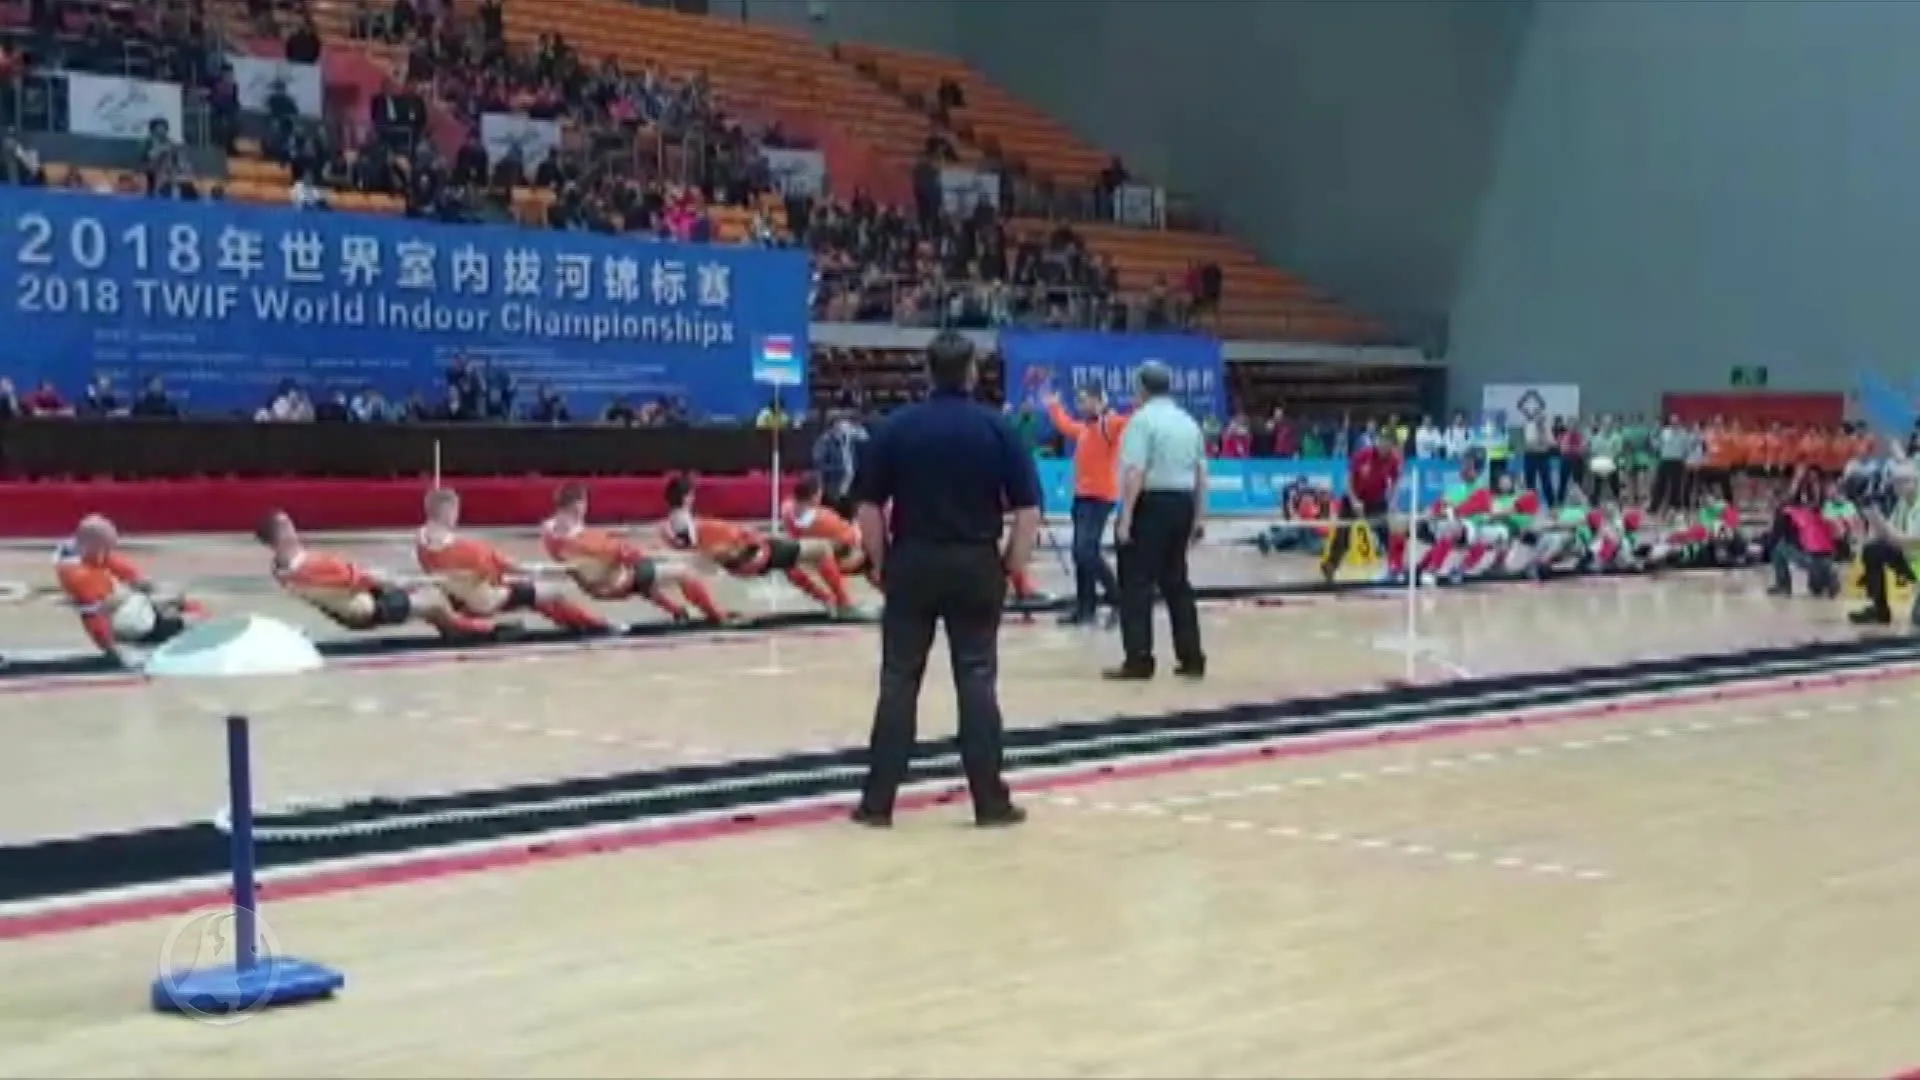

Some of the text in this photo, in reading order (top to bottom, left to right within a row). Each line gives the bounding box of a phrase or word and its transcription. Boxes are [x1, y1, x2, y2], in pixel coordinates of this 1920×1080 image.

[17, 274, 119, 314] 2018
[135, 279, 239, 318] TWIF
[251, 286, 364, 325] World
[378, 296, 490, 331] Indoor
